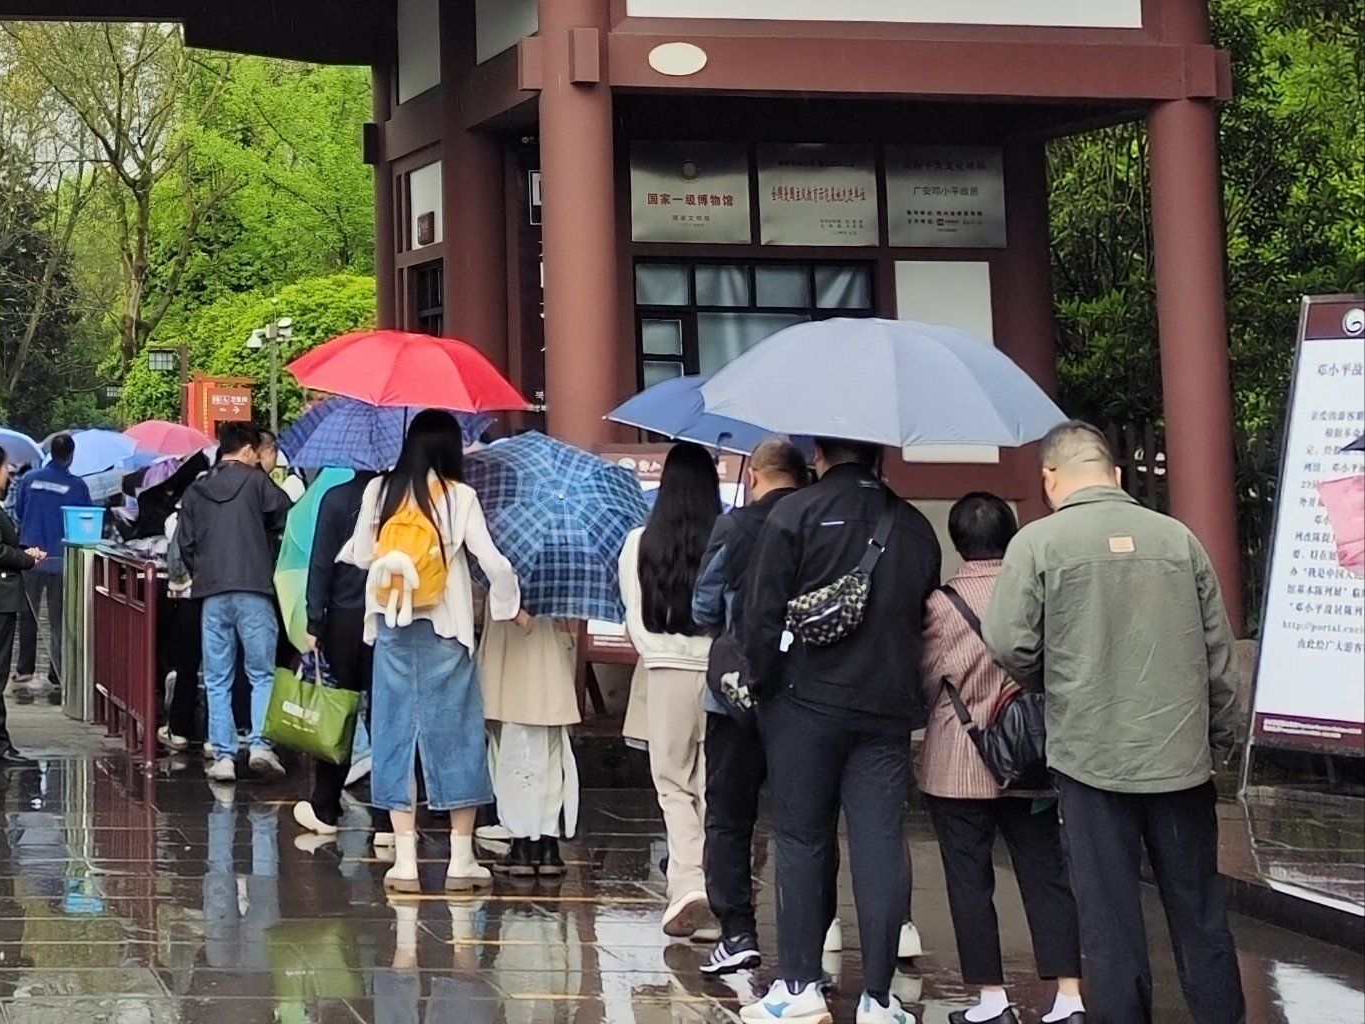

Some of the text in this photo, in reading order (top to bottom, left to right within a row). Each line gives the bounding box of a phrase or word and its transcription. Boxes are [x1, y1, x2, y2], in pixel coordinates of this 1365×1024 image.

[912, 185, 980, 197] 广安邓小平故居
[647, 192, 735, 208] 国家一级博物馆
